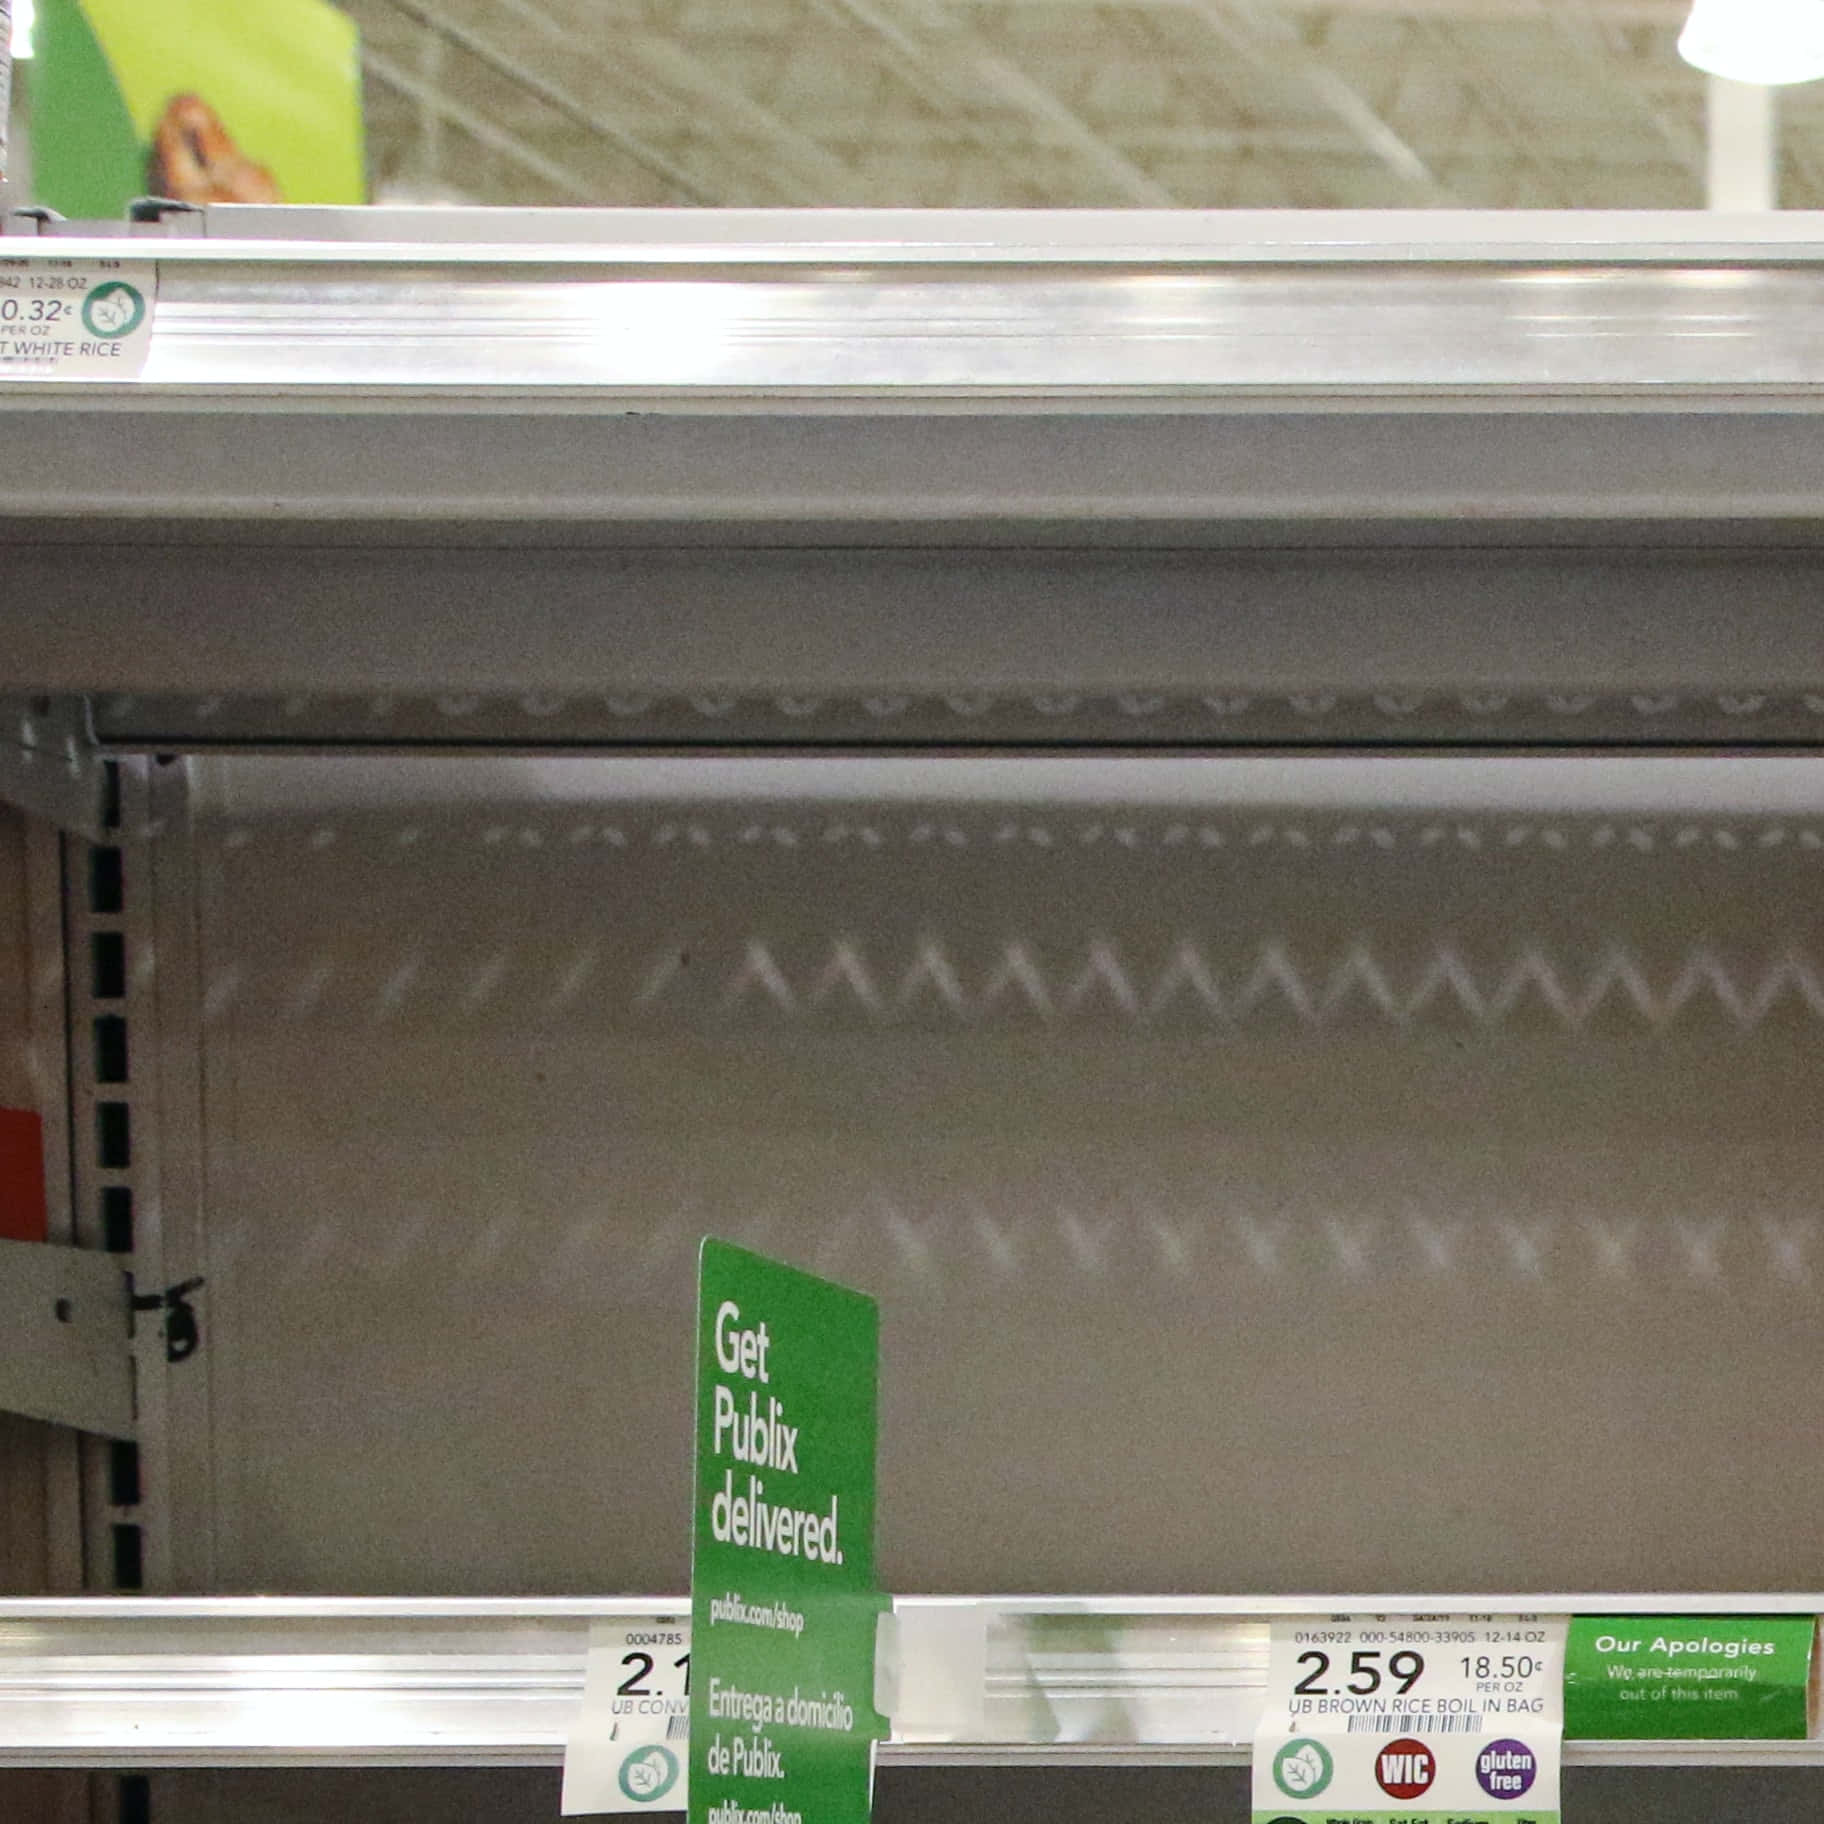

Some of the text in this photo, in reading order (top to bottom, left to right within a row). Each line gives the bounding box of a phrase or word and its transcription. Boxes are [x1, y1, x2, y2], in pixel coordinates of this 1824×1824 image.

[14, 342, 121, 357] WHITE RICE
[714, 1300, 770, 1383] Get
[714, 1384, 799, 1474] Publix
[711, 1468, 843, 1565] delivered.
[710, 1593, 805, 1639] publix.com/shop
[1595, 1636, 1776, 1658] Our Apologies
[1294, 1651, 1425, 1695] 2.59
[1460, 1656, 1543, 1678] 18.50¢
[709, 1677, 853, 1733] Entrega a domicilio
[1288, 1698, 1544, 1714] UB BROWN RICE BOIL IN BAG
[1620, 1686, 1738, 1700] out of this item
[708, 1733, 784, 1778] de Publix.
[1381, 1754, 1429, 1784] WIC
[1480, 1751, 1532, 1772] gluten
[1490, 1772, 1522, 1790] free
